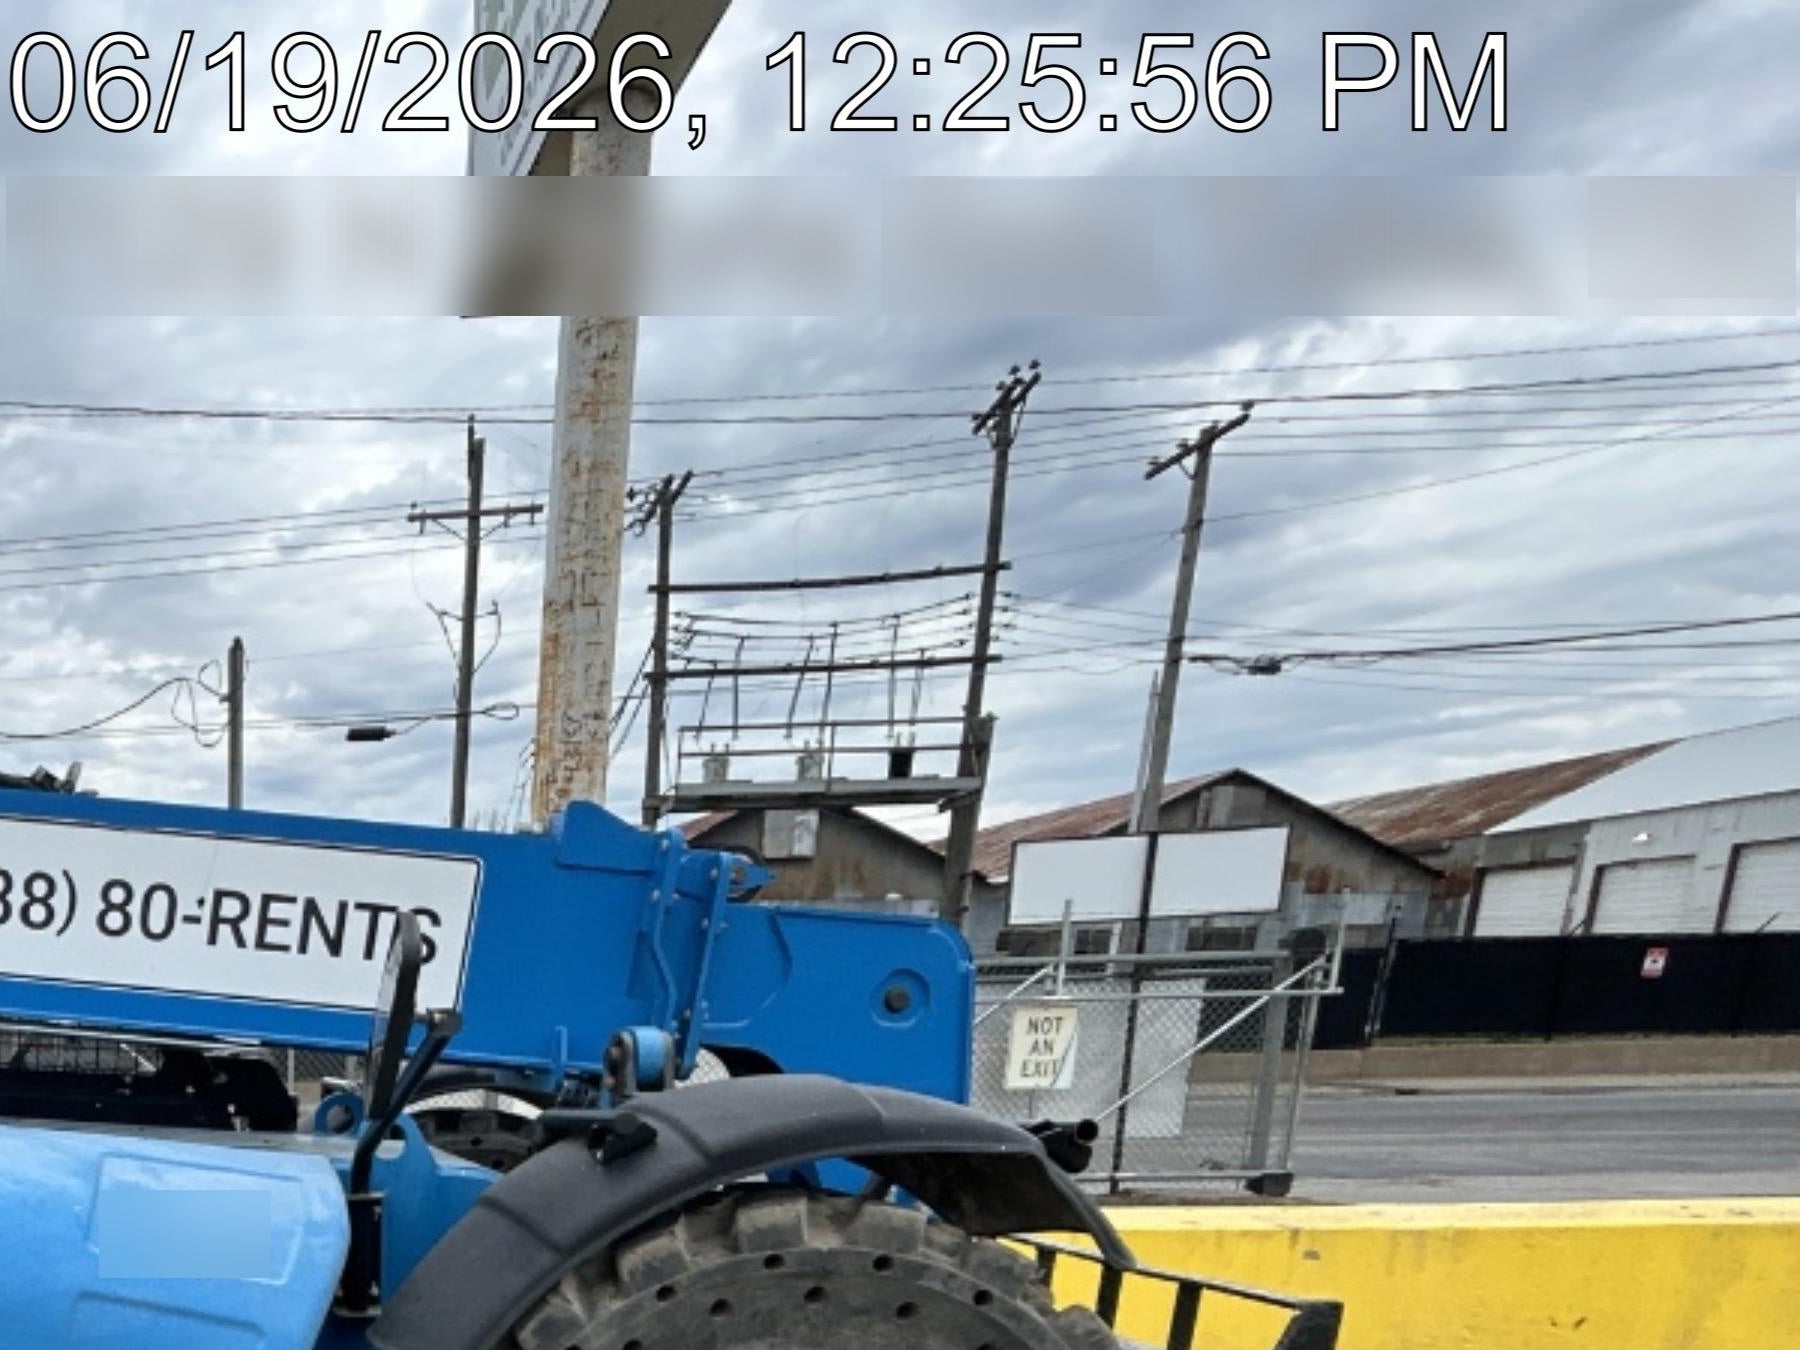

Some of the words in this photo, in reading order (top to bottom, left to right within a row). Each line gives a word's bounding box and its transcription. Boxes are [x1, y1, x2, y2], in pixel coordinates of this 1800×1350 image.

[1026, 1015, 1064, 1035] NOT
[1029, 1037, 1055, 1056] AN
[1020, 1058, 1060, 1078] EXIT
